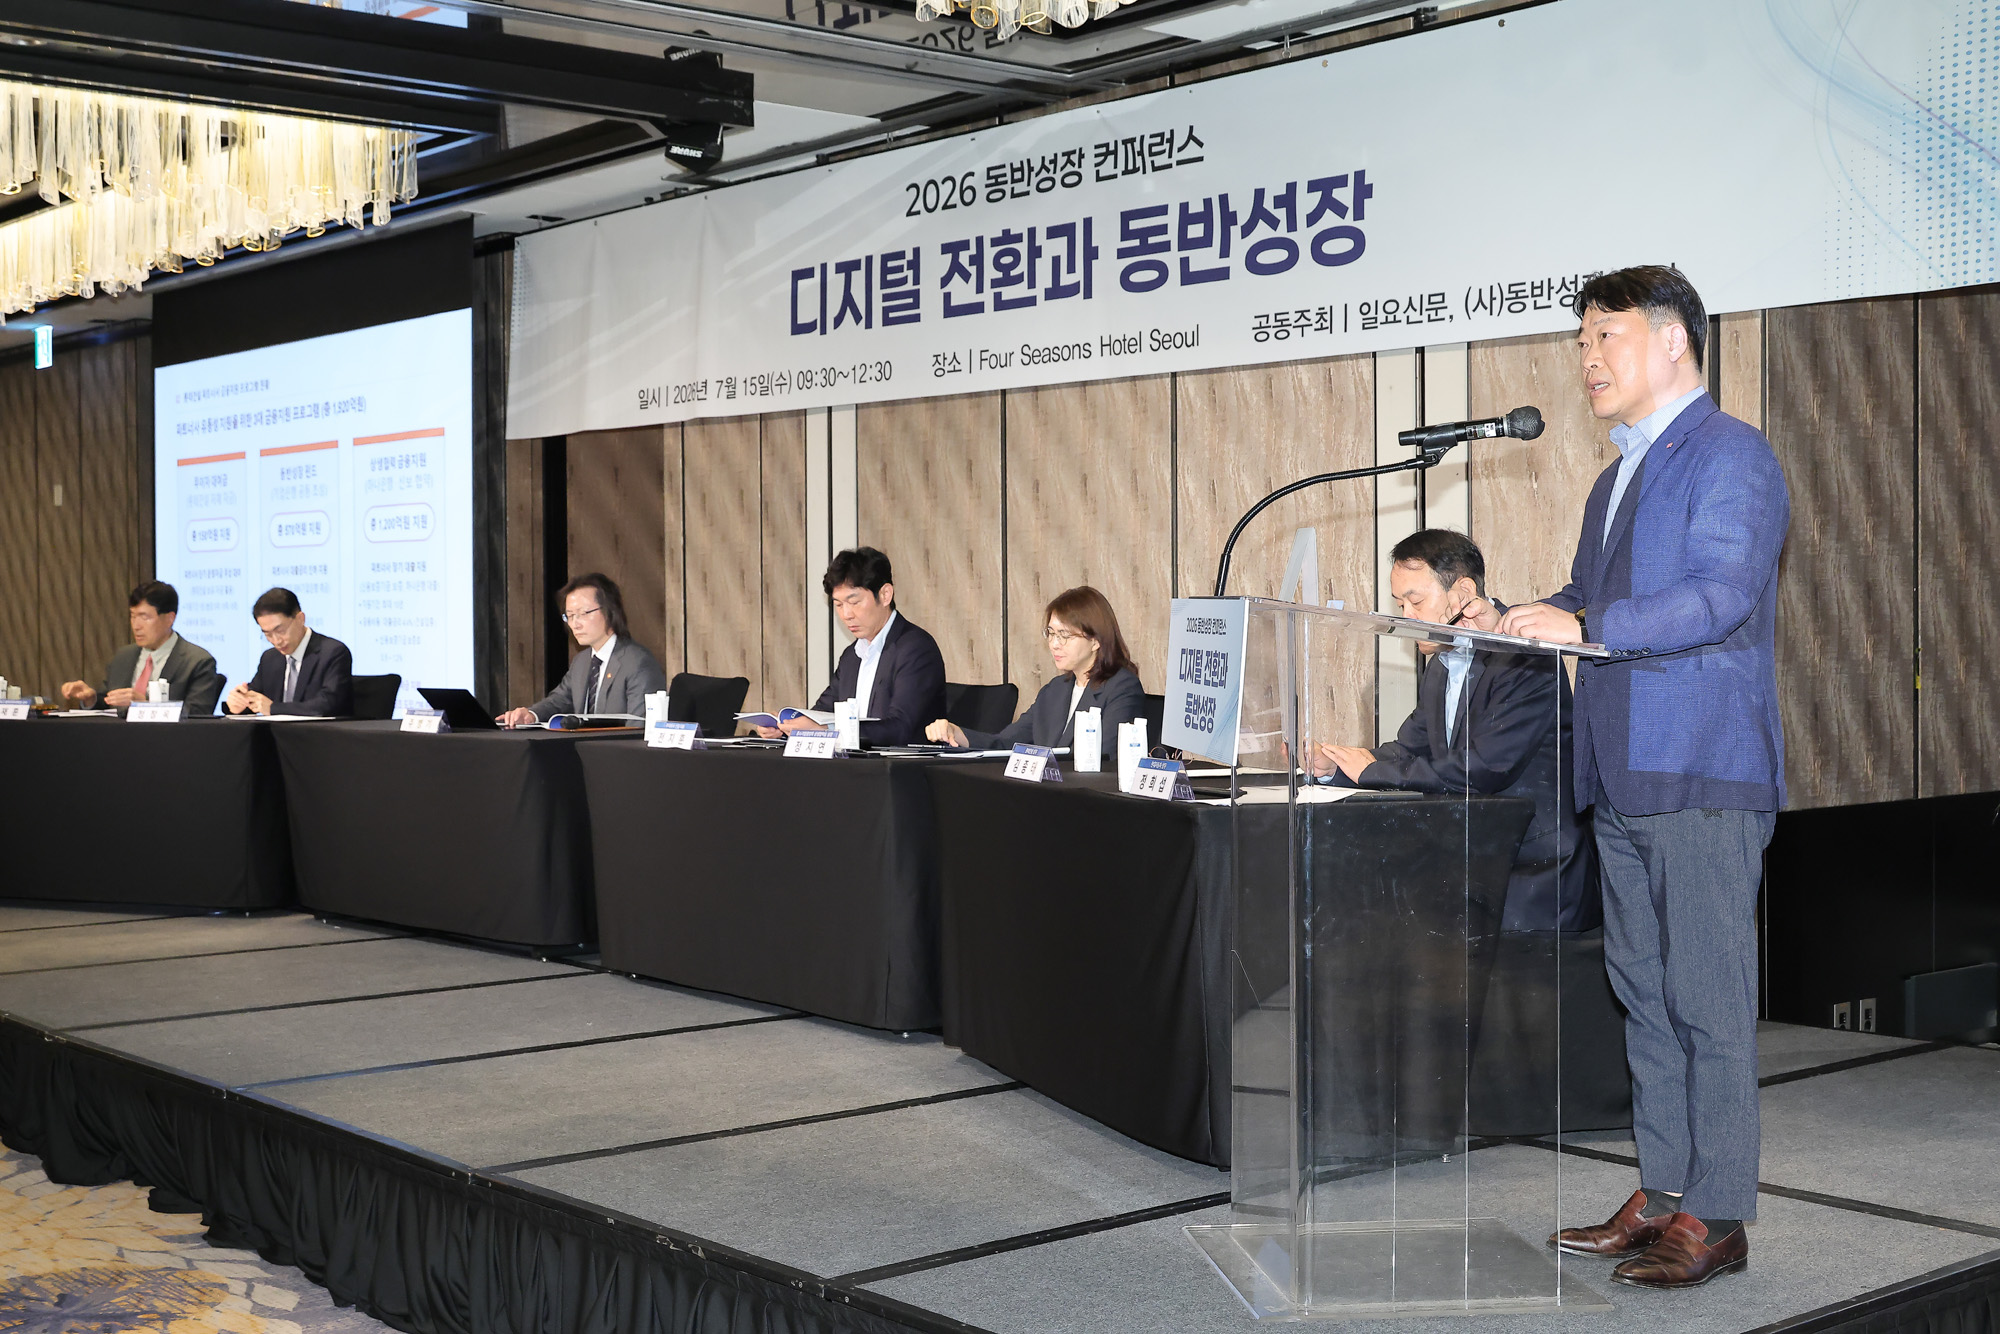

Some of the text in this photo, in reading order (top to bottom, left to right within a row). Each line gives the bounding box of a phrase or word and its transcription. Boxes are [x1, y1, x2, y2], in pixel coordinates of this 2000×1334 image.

[905, 124, 1205, 217] 2026 동반성장 컨퍼런스
[790, 168, 1374, 336] 디지털 전환과 동반성장
[1251, 305, 1334, 343] 공동주최
[1359, 291, 1455, 331] 일요신문,
[931, 323, 1200, 378] 장소 Four Seasons Hotel Seoul
[638, 360, 893, 409] 일시 2026년 7월 15일(수) 09:30~12:30
[293, 402, 320, 420] 프로그램
[1186, 617, 1197, 633] 2026
[1197, 617, 1212, 635] 동반성장
[1179, 648, 1229, 689] 디지털 전환과
[1184, 692, 1217, 734] 동반성장
